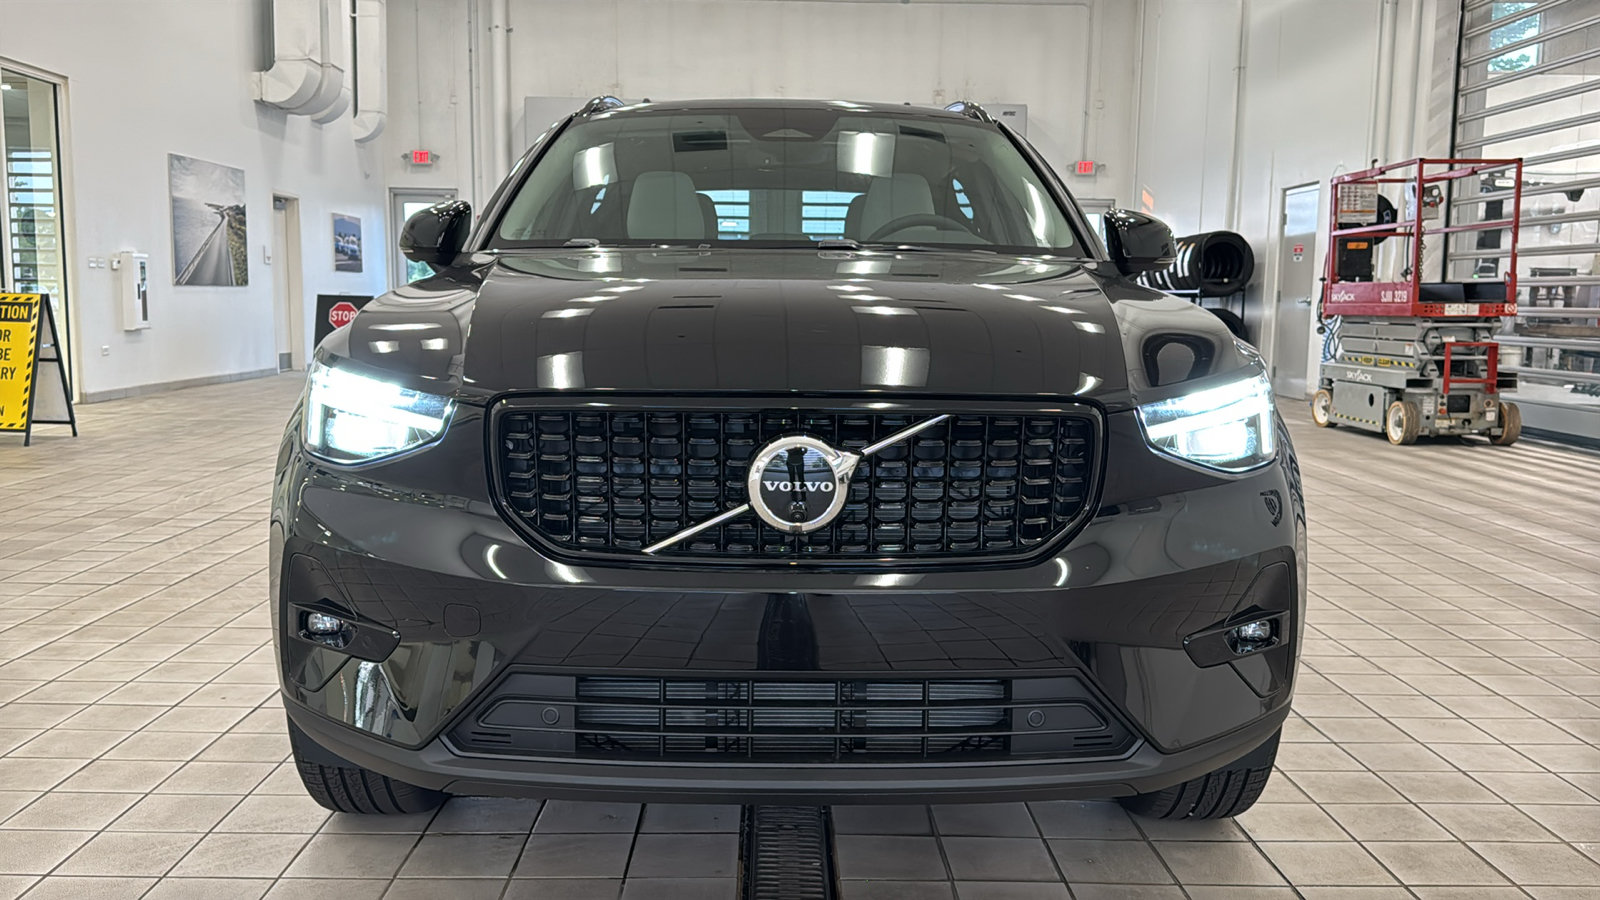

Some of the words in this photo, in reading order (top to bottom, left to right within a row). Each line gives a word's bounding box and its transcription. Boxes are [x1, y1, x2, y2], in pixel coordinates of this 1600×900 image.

[1394, 290, 1408, 303] 3219
[0, 304, 29, 319] TION
[331, 310, 356, 321] STOP
[762, 481, 834, 492] VOLVO
